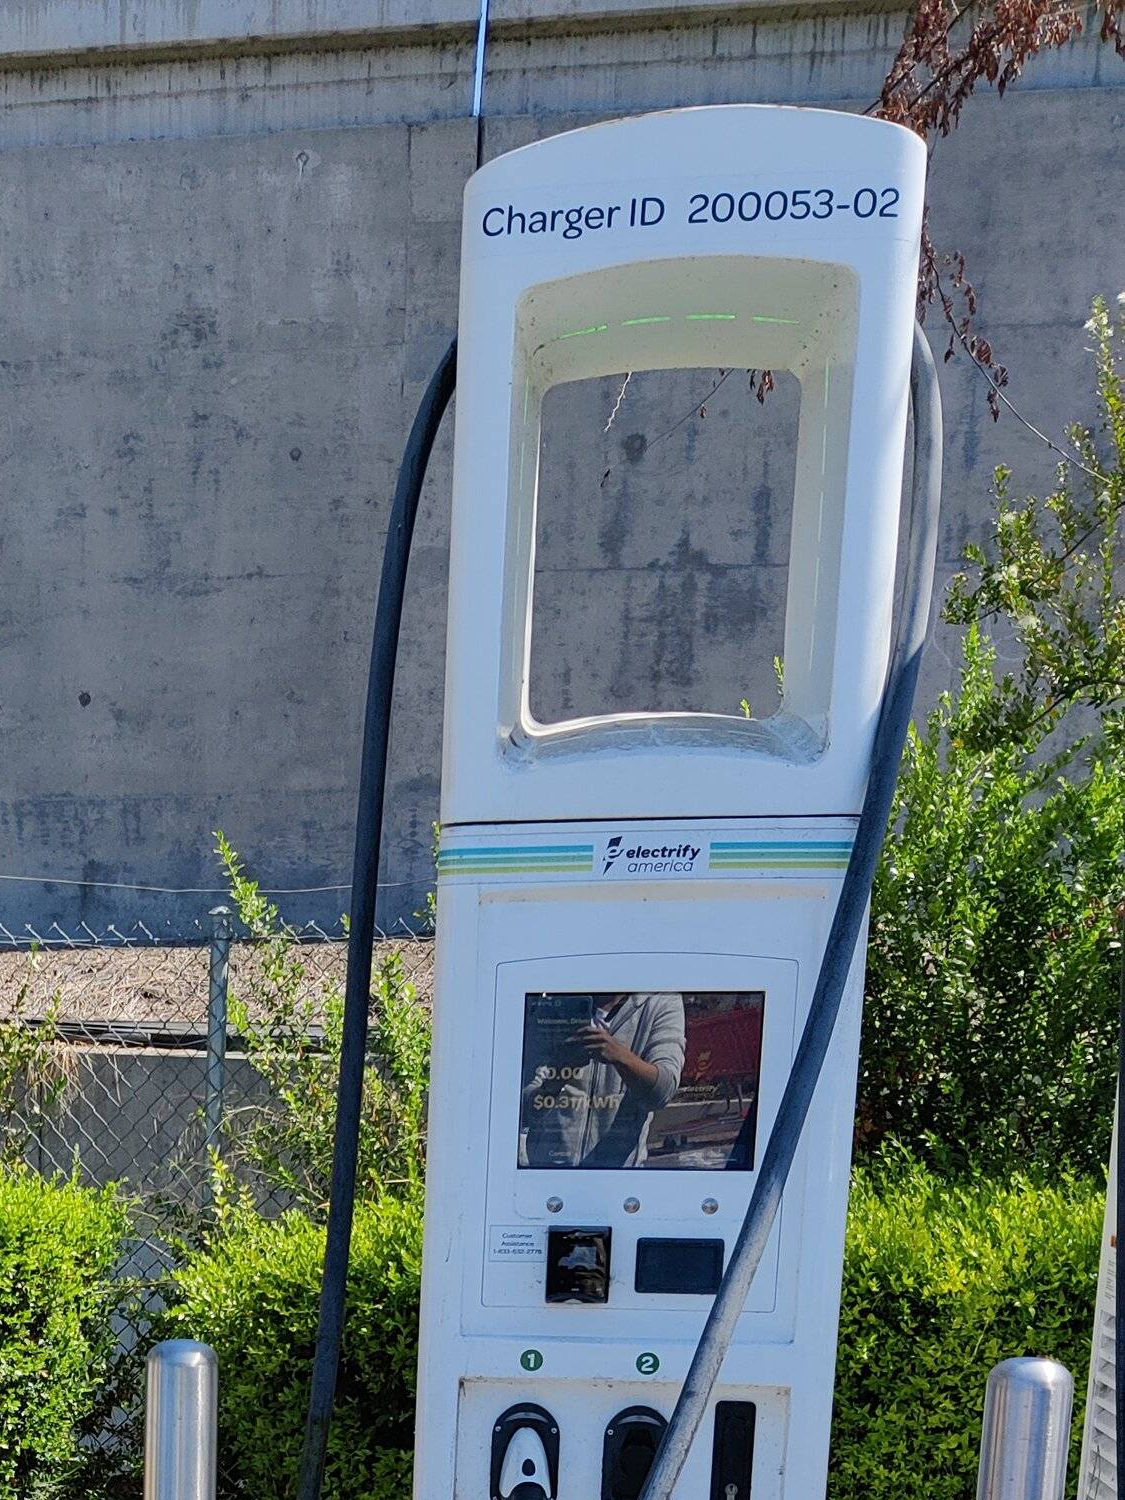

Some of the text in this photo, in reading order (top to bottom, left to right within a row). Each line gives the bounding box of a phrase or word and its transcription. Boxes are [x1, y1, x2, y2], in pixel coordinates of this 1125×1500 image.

[481, 187, 901, 240] Charger ID 200053-02
[626, 844, 701, 861] electrify
[627, 860, 694, 873] america
[641, 1355, 654, 1372] 2
